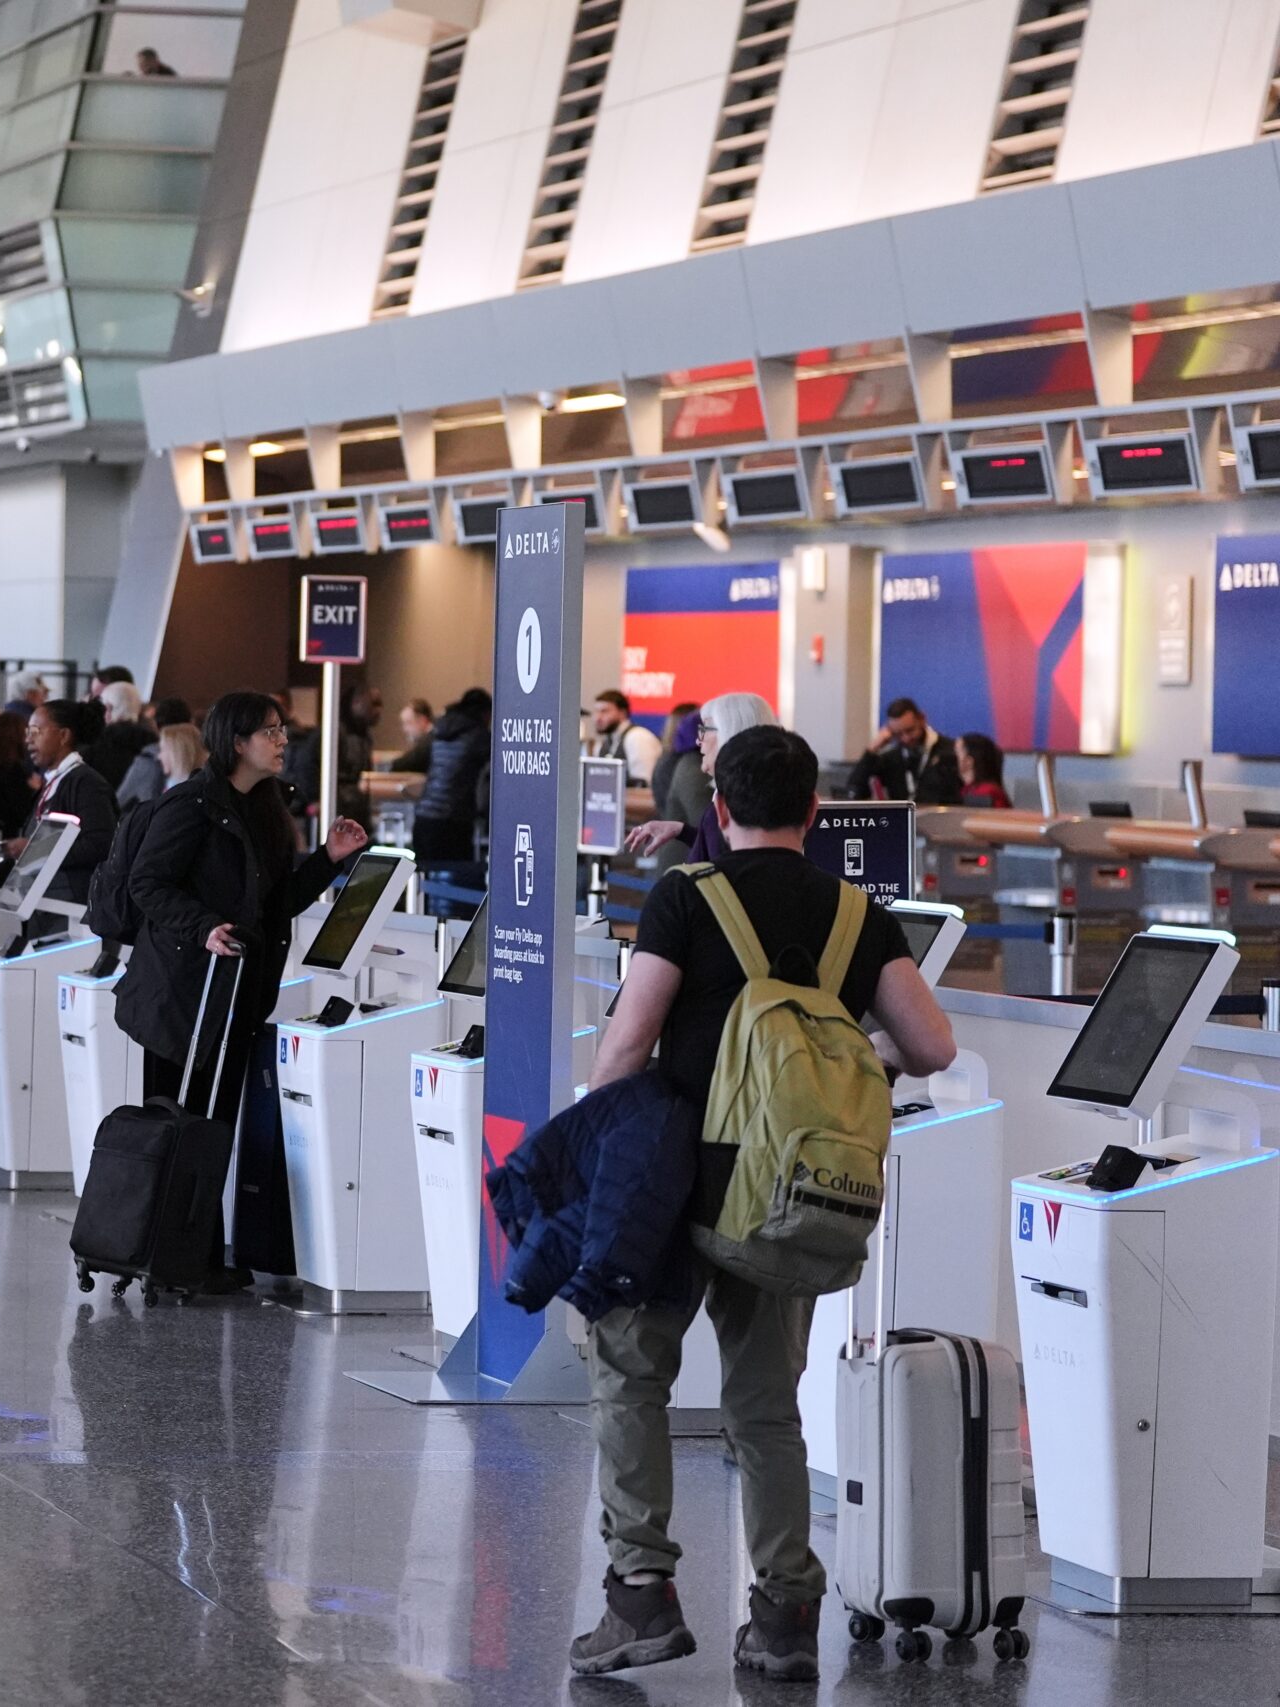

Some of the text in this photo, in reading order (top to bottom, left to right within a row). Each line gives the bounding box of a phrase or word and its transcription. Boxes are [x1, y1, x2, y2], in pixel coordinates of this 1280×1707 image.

[515, 531, 550, 556] DELTA
[1233, 562, 1279, 588] DELTA
[313, 605, 358, 625] EXIT
[526, 625, 533, 677] 1
[501, 718, 552, 744] SCAN & TAG
[502, 750, 550, 776] YOUR BAGS
[833, 818, 876, 828] DELTA
[878, 883, 900, 893] THE
[874, 894, 895, 905] APP
[494, 925, 505, 939] Scan
[505, 930, 515, 943] your
[521, 928, 533, 943] Delta
[533, 933, 543, 947] app
[494, 944, 513, 963] boarding
[512, 950, 523, 963] pass
[528, 949, 539, 964] kiosk
[493, 964, 504, 980] print
[504, 965, 513, 982] bag
[1043, 1344, 1076, 1368] DELTA
